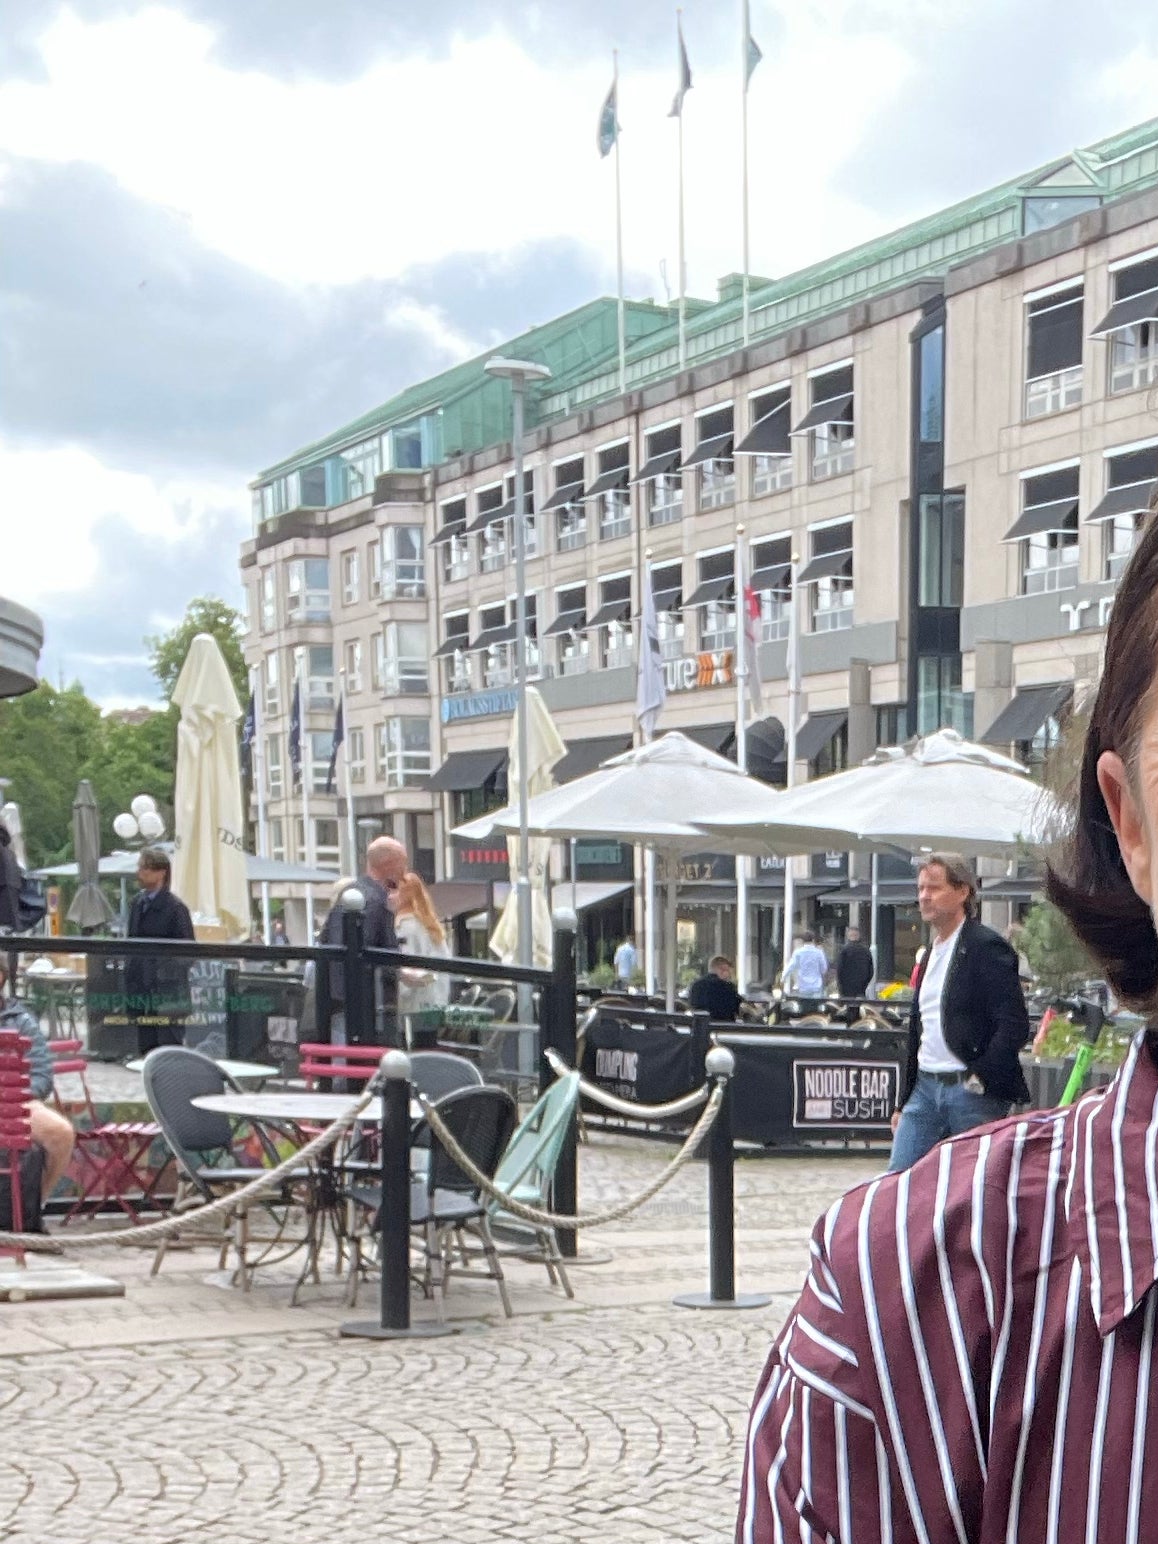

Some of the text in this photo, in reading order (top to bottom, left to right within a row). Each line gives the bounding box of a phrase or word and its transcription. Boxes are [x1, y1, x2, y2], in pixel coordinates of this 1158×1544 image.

[804, 1068, 889, 1100] NOODLE BAR
[832, 1100, 890, 1119] SUSHI
